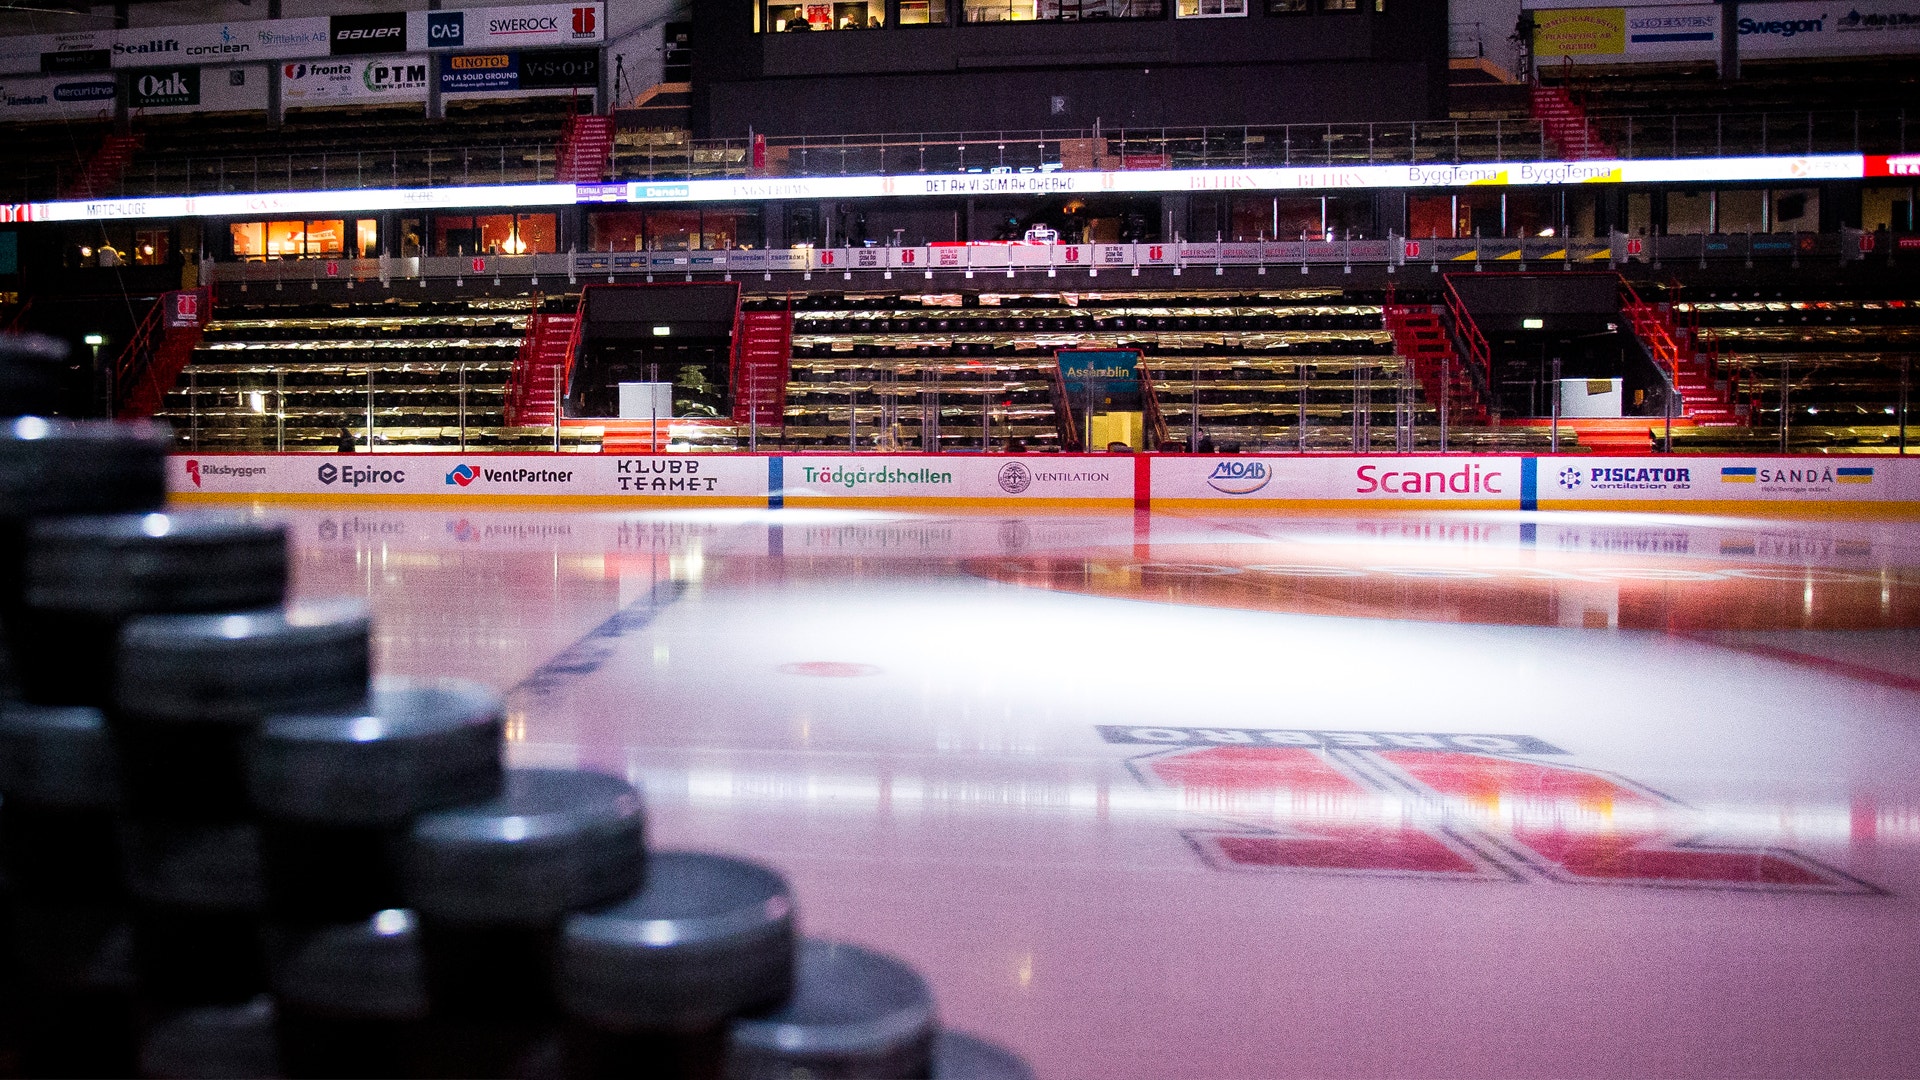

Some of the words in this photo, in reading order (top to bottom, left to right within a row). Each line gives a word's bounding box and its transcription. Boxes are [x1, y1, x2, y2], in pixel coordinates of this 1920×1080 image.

[489, 17, 558, 32] SWEROCK
[1737, 18, 1823, 37] Swegon
[312, 32, 327, 42] AB
[336, 27, 402, 40] BAUER
[112, 39, 180, 55] Sealift
[186, 42, 250, 56] conclean
[453, 56, 508, 68] LINOTOL
[310, 65, 351, 76] fronta
[374, 65, 426, 83] PTM
[463, 73, 484, 81] SOLID
[485, 72, 518, 80] GROUND
[57, 87, 91, 97] Mercuri
[91, 86, 114, 96] Urval
[138, 72, 190, 97] Oak
[1408, 166, 1497, 185] ByggTema
[1521, 164, 1611, 183] ByggTema
[926, 180, 947, 193] DET
[969, 179, 980, 192] VI
[982, 178, 1008, 192] SOM
[202, 464, 266, 477] Riksbyggen
[617, 460, 699, 474] KLUBB
[1208, 462, 1267, 479] MOAB
[342, 465, 405, 487] Epiroc
[484, 468, 573, 483] VentPartner
[802, 465, 952, 488] Trädgårdshallen
[1035, 472, 1109, 482] VENTILATION
[1356, 464, 1502, 494] Scandic
[1590, 468, 1691, 482] PISCATOR
[1760, 466, 1834, 483] SANDÅ
[617, 477, 718, 491] TEAMET
[1673, 482, 1691, 490] ab
